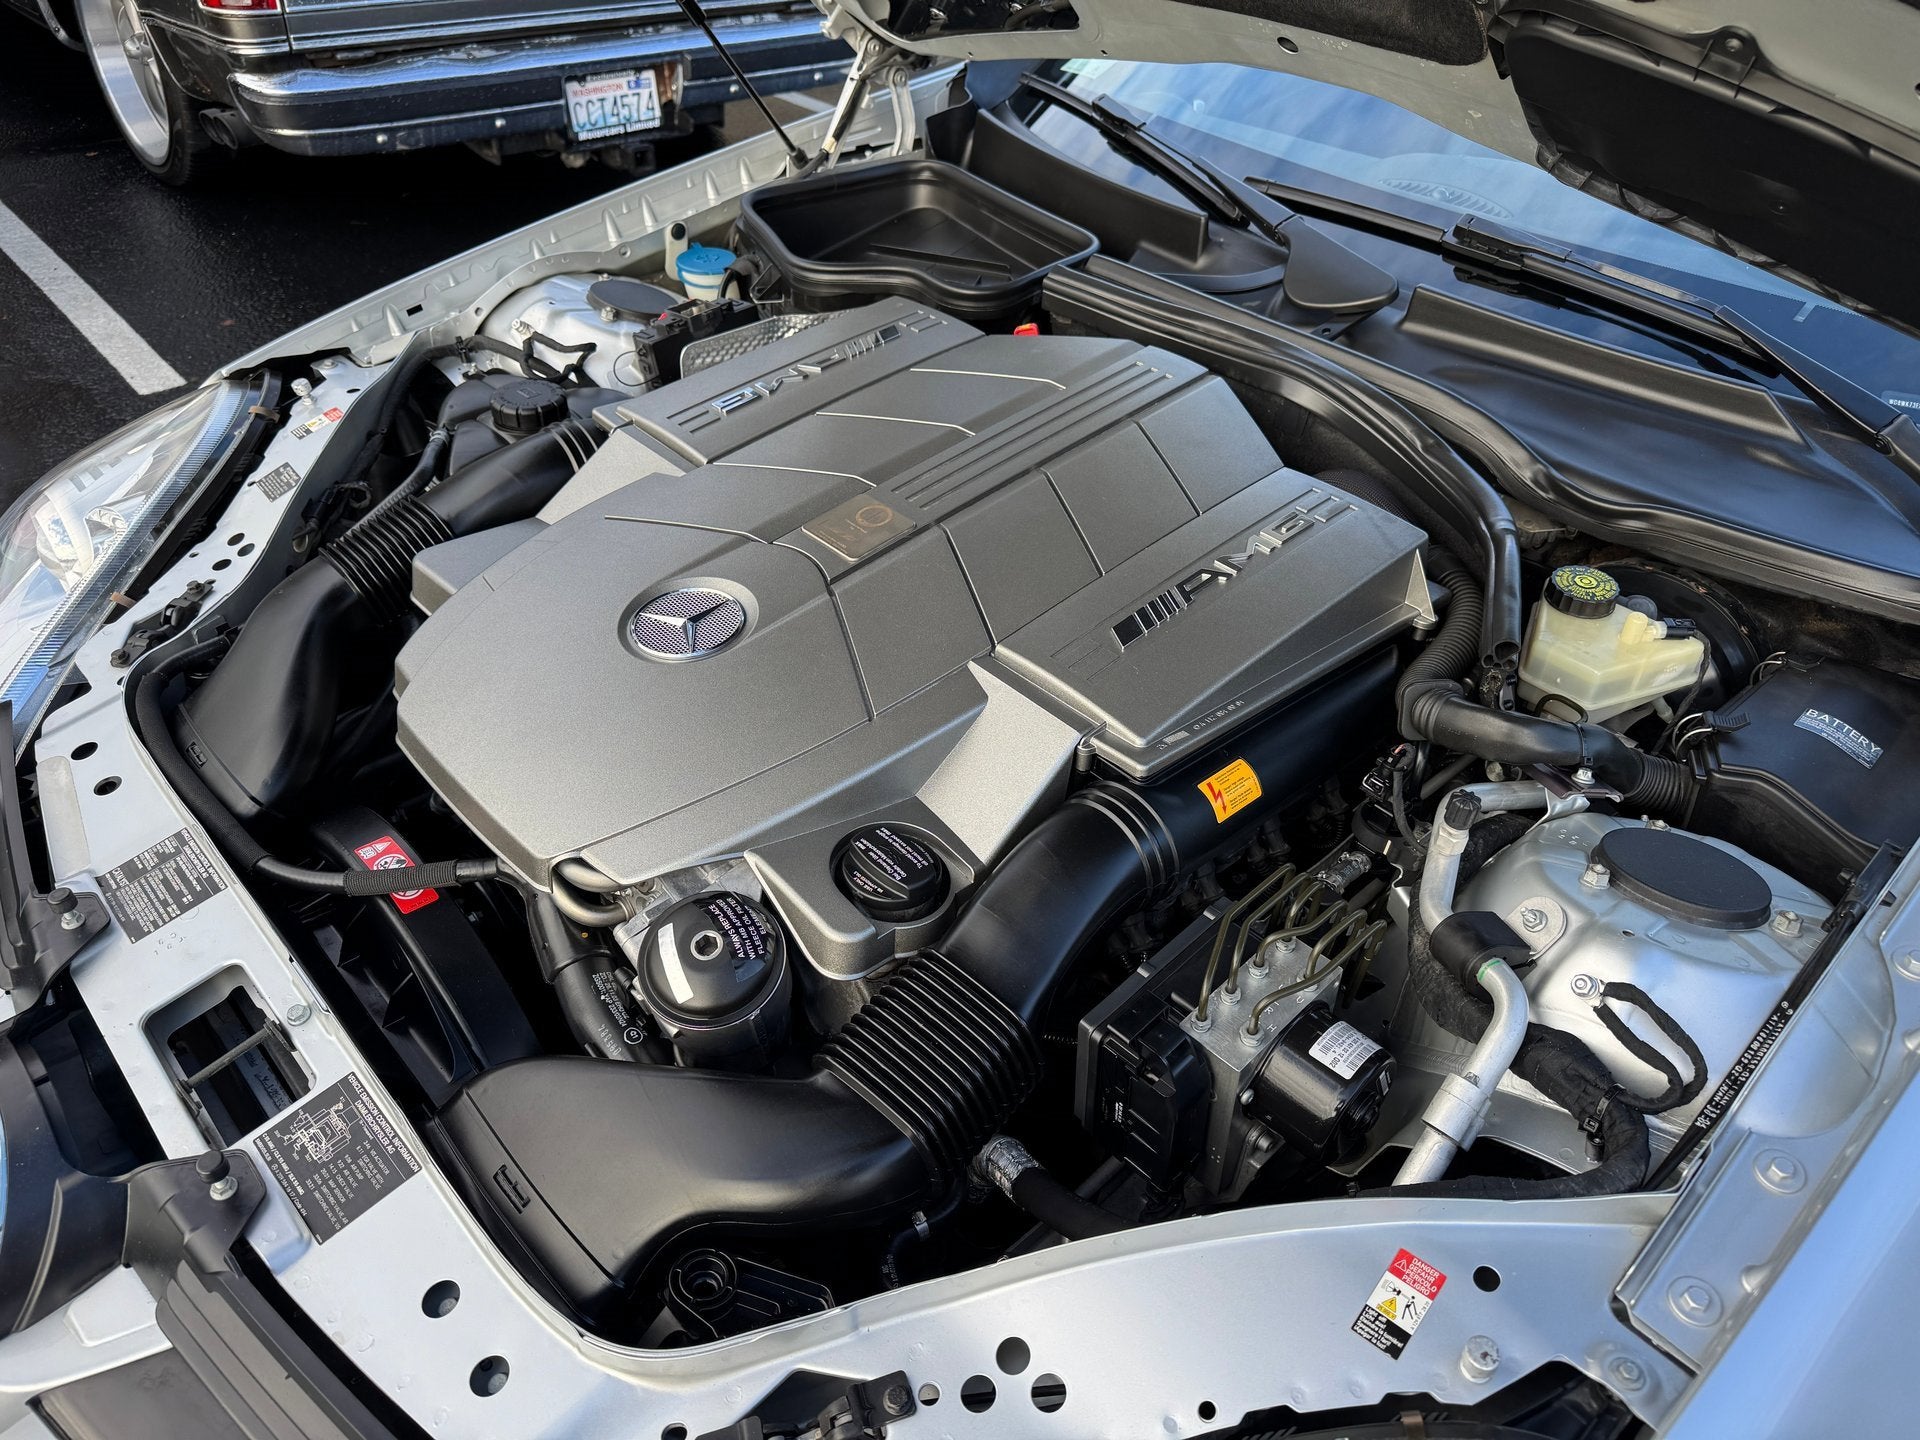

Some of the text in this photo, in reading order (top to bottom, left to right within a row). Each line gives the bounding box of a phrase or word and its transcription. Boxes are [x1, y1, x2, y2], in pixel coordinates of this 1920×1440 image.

[571, 82, 623, 98] WASHINGTON
[572, 90, 656, 131] CCT4574
[1179, 512, 1316, 610] AMG
[1806, 708, 1881, 754] BATTERY
[708, 903, 745, 959] ALWAYS REPLACE
[716, 898, 756, 959] WITH MB APPROVED
[726, 896, 765, 954] FLEECE OIL FILTER
[346, 1073, 364, 1094] VEHICLE
[359, 1091, 379, 1116] EMISSION
[375, 1113, 396, 1139] CONTROL
[391, 1136, 420, 1173] INFORMATION
[354, 1099, 390, 1146] DAIMLERCHRYSLER
[385, 1143, 396, 1154] AG
[295, 1184, 305, 1195] AMG
[1404, 1268, 1438, 1293] PERICOLO
[1407, 1263, 1435, 1283] GEFAHR
[1411, 1257, 1440, 1278] DANGER
[1400, 1274, 1431, 1296] PELIGRO
[1361, 1310, 1375, 1321] Licht
[1364, 1306, 1378, 1317] Light
